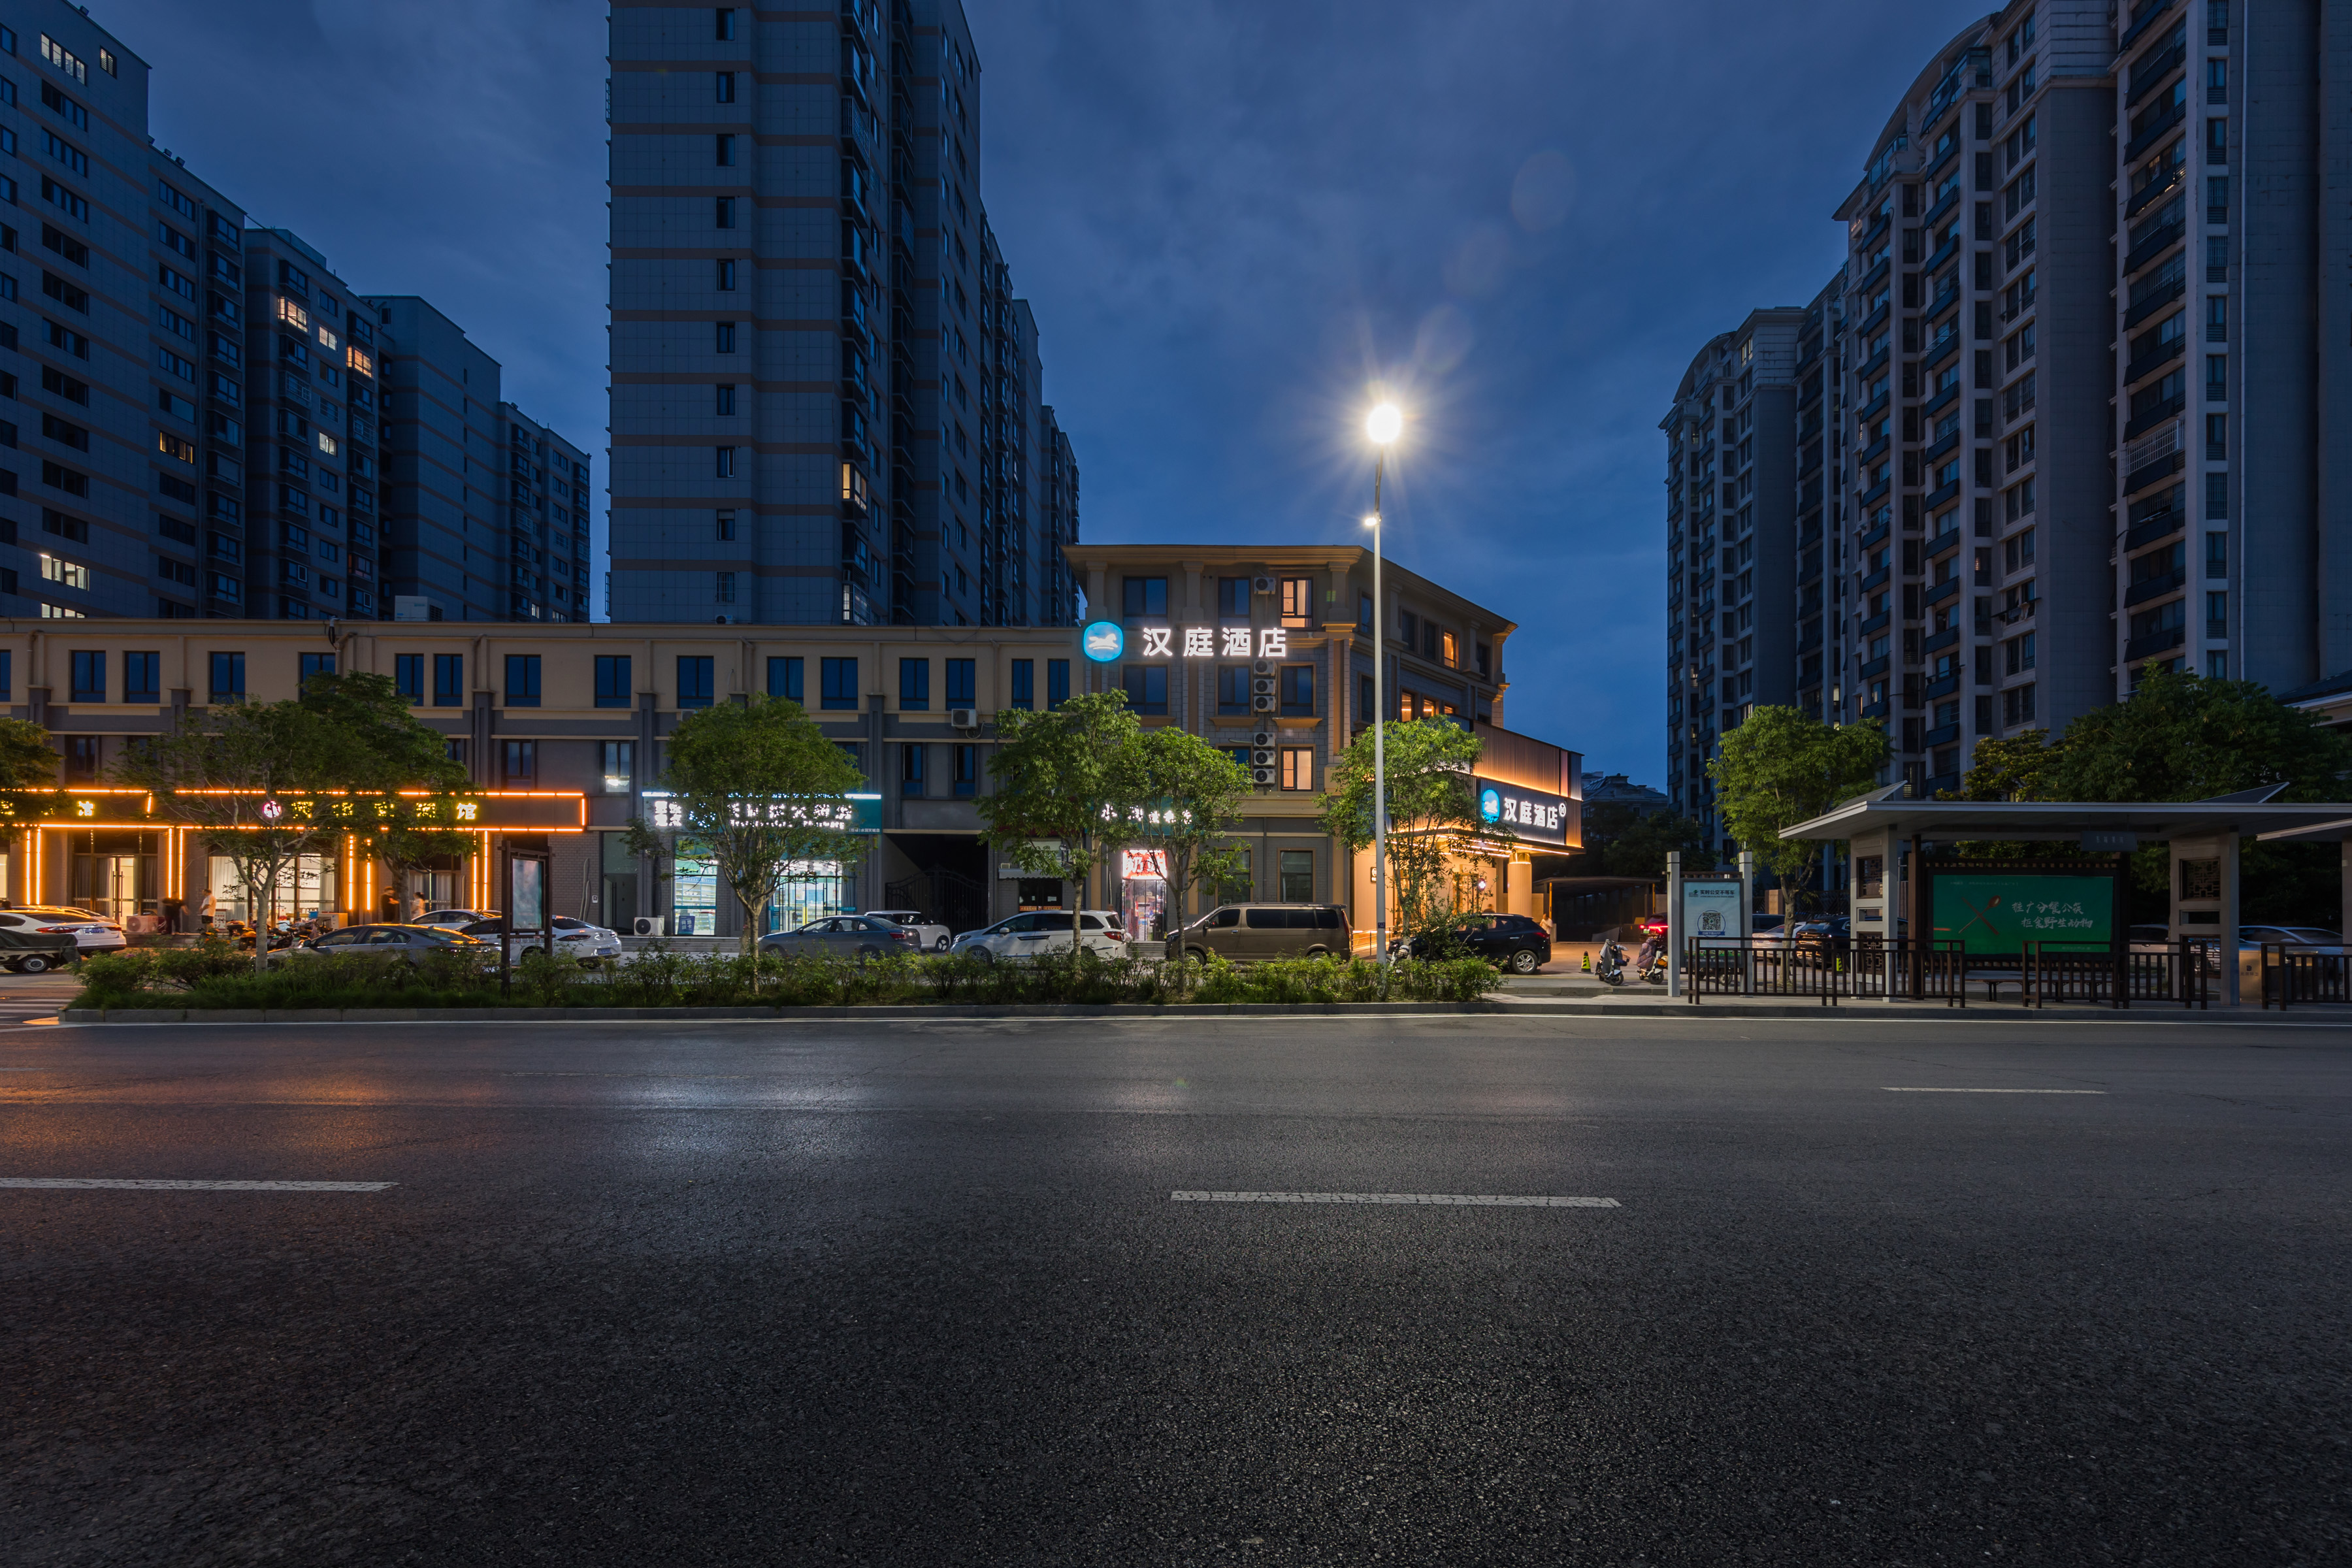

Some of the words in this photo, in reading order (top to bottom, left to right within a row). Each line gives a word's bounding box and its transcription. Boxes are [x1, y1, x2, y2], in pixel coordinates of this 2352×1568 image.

[1143, 627, 1286, 657] 汉庭酒店
[1503, 797, 1558, 829] 汉庭酒店
[2012, 900, 2084, 915] 推广分餐公筷
[2020, 916, 2094, 929] 拒食野生动物
